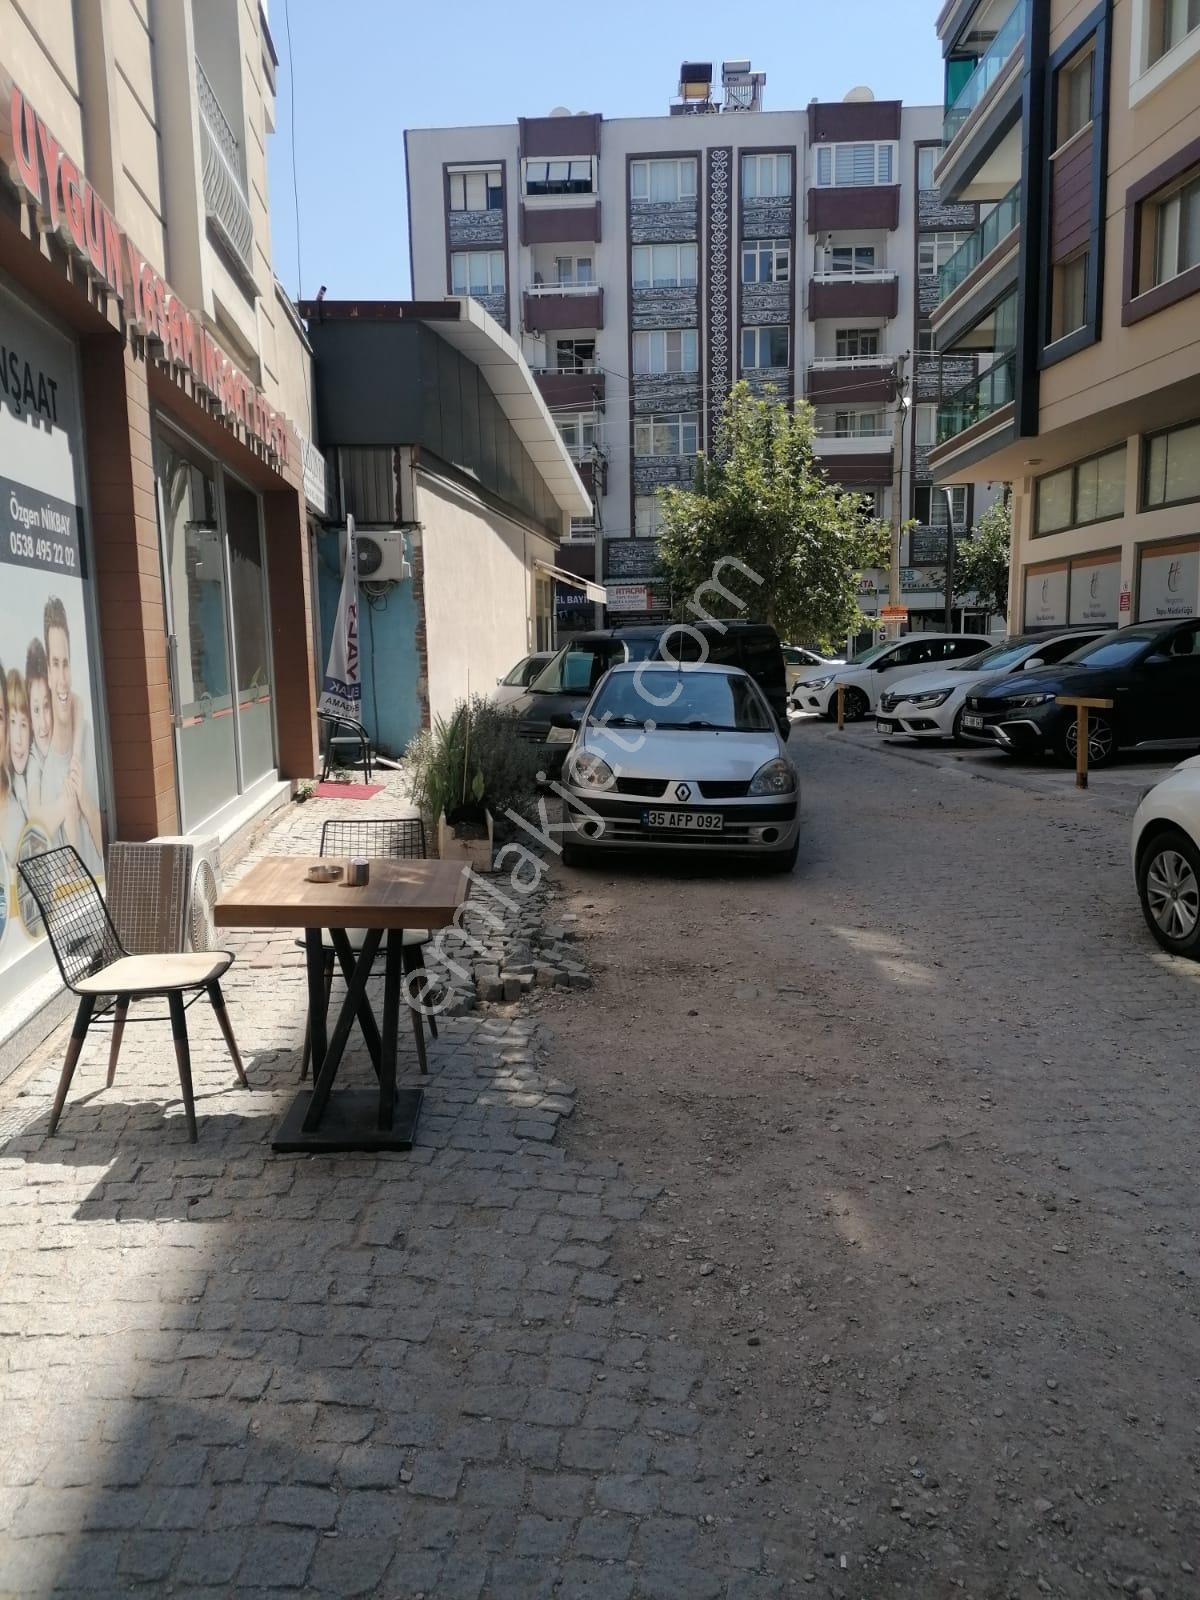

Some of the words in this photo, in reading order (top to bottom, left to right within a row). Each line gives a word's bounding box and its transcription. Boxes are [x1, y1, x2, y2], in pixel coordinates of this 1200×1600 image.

[11, 83, 124, 300] UYGUN
[10, 491, 40, 529] Özgen
[41, 504, 70, 536] NİKBAY
[10, 531, 34, 558] 0538
[36, 537, 51, 562] 495
[53, 543, 64, 564] 22
[65, 546, 75, 567] 02
[650, 812, 665, 826] 35
[669, 814, 693, 828] AFP
[697, 815, 722, 829] 092
